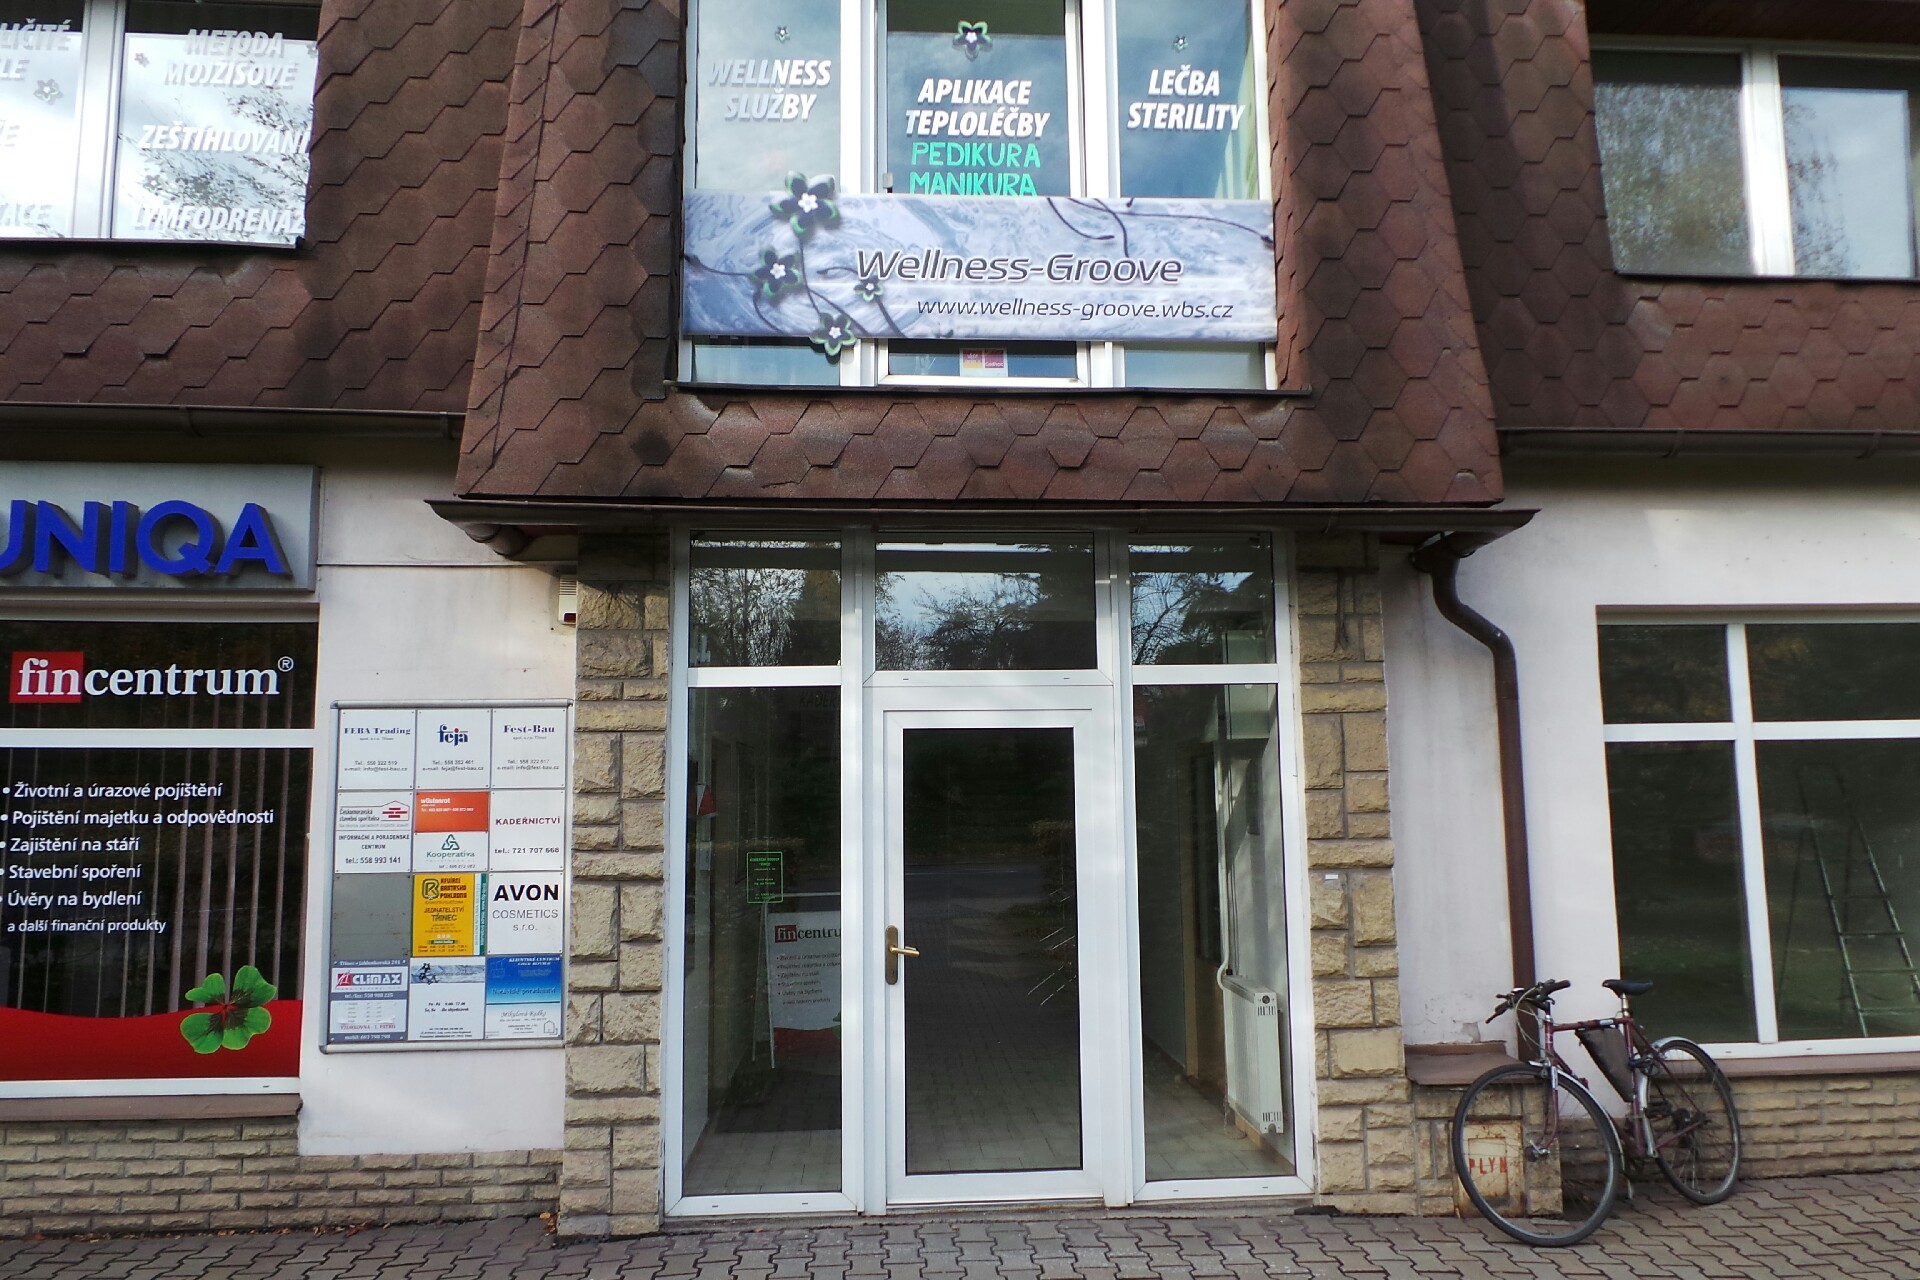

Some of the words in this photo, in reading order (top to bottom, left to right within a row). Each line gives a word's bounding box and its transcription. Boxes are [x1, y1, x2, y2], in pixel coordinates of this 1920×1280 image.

[185, 28, 284, 58] METODA
[709, 59, 831, 88] WELLNESS
[1148, 64, 1220, 98] LEČBA
[917, 78, 1032, 105] APLIKACE
[725, 87, 817, 122] SLUŽBY
[905, 106, 1050, 138] TEPLOLÉČBY
[1127, 101, 1246, 131] STERILITY
[911, 142, 1041, 168] PEDIKURA
[909, 171, 1038, 196] MANIKURA
[856, 248, 1183, 283] Wellness-Groove
[917, 297, 1234, 322] www.wellness-groove.wbs.cz
[373, 727, 411, 735] Trading
[437, 723, 468, 746] feja
[504, 724, 555, 733] Fest-Bau
[14, 781, 71, 798] Životní
[73, 786, 83, 798] a
[88, 782, 151, 798] úrazové
[154, 782, 222, 800] pojištění
[12, 809, 80, 828] Pojištění
[84, 809, 149, 828] majetku
[153, 814, 162, 824] a
[166, 809, 274, 828] odpovědnosti
[495, 816, 561, 825] KADEŘNICTVÍ
[10, 838, 78, 855] Zajištění
[81, 841, 101, 852] na
[105, 837, 140, 852] stáří
[426, 850, 475, 860] Kooperativa
[389, 856, 401, 864] 141
[9, 864, 78, 879] Stavební
[82, 864, 141, 882] spoření
[8, 891, 53, 909] Úvěry
[57, 895, 78, 905] na
[82, 891, 141, 908] bydlení
[493, 884, 559, 901] AVON
[492, 909, 559, 919] COSMETICS
[7, 921, 15, 932] a
[18, 919, 48, 932] další
[51, 919, 104, 932] finanční
[108, 918, 166, 934] produkty
[1468, 1156, 1509, 1175] PLYN
